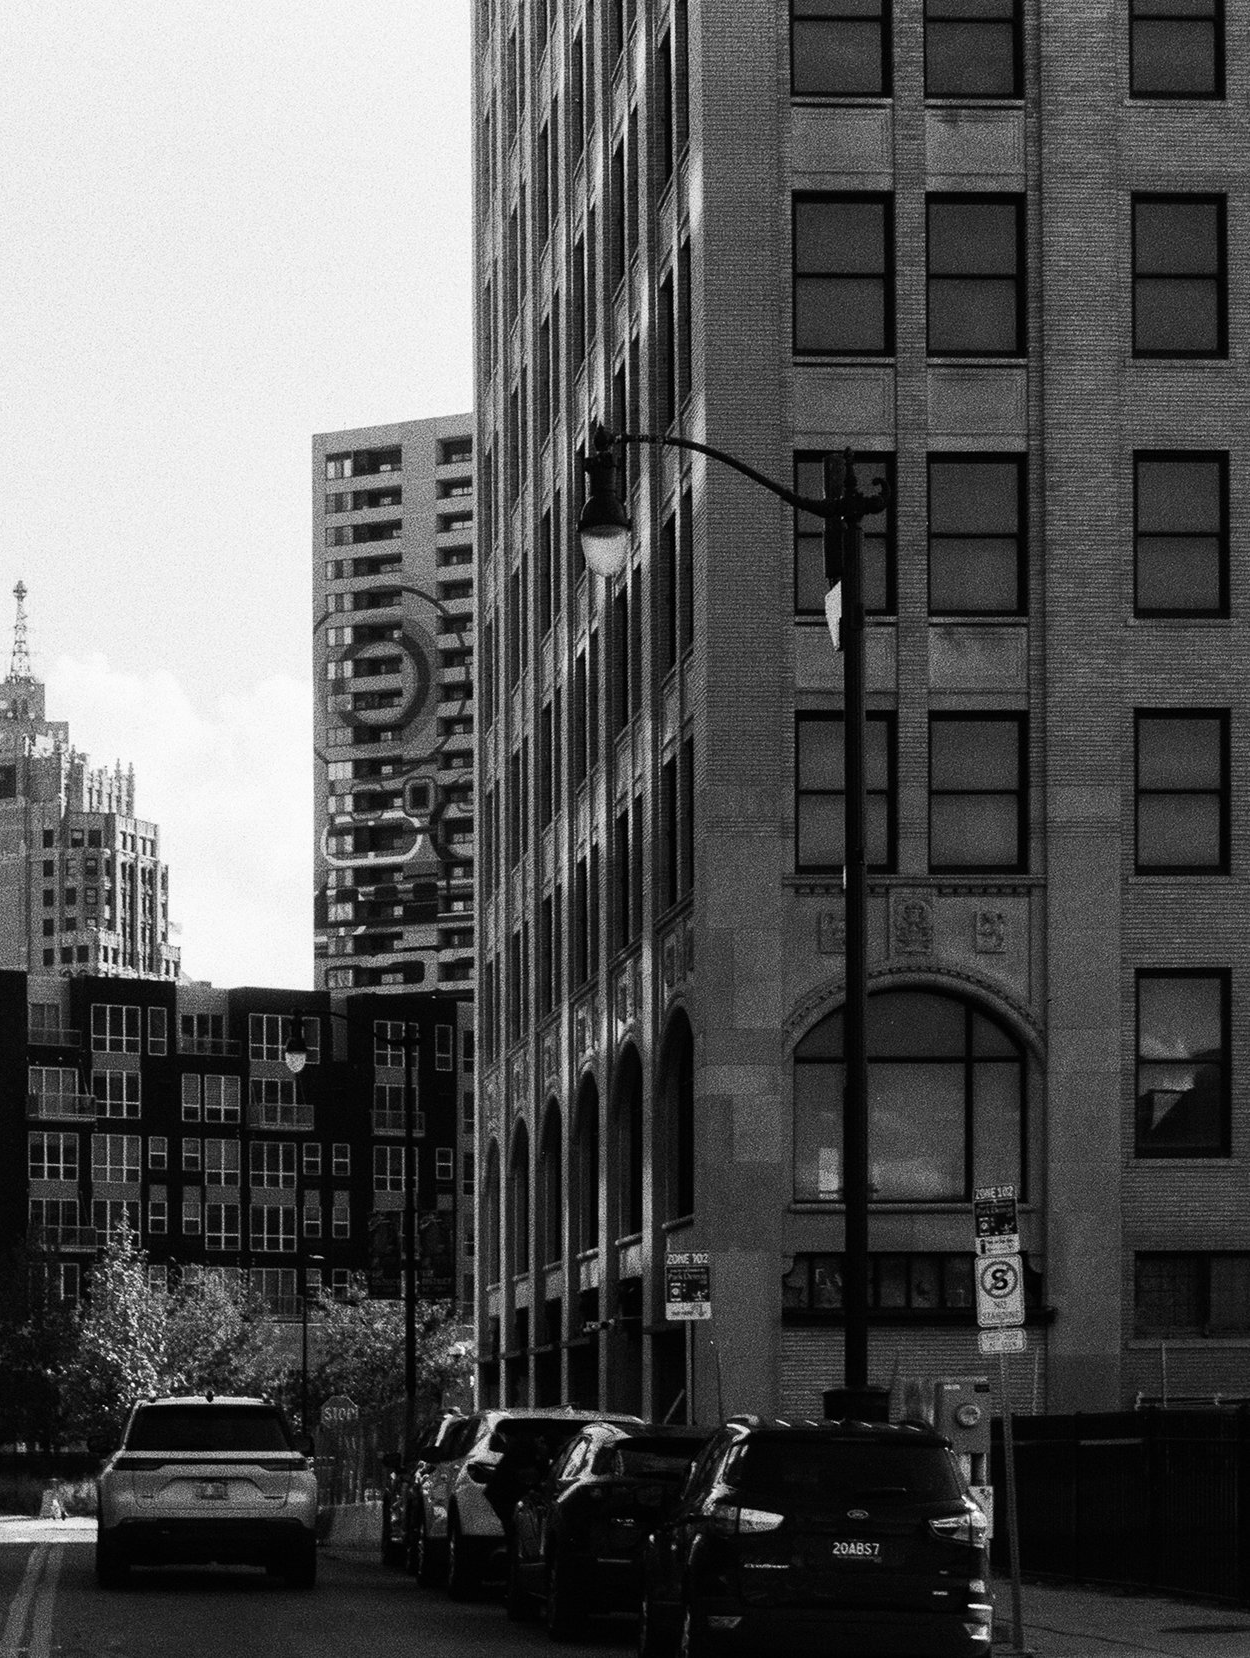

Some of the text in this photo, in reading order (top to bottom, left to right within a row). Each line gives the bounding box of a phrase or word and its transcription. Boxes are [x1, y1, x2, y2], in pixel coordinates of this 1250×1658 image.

[974, 1185, 1014, 1200] ZONE 102
[666, 1253, 709, 1265] ZONE 102
[993, 1301, 1007, 1309] NO
[832, 1541, 880, 1556] 20ABS7
